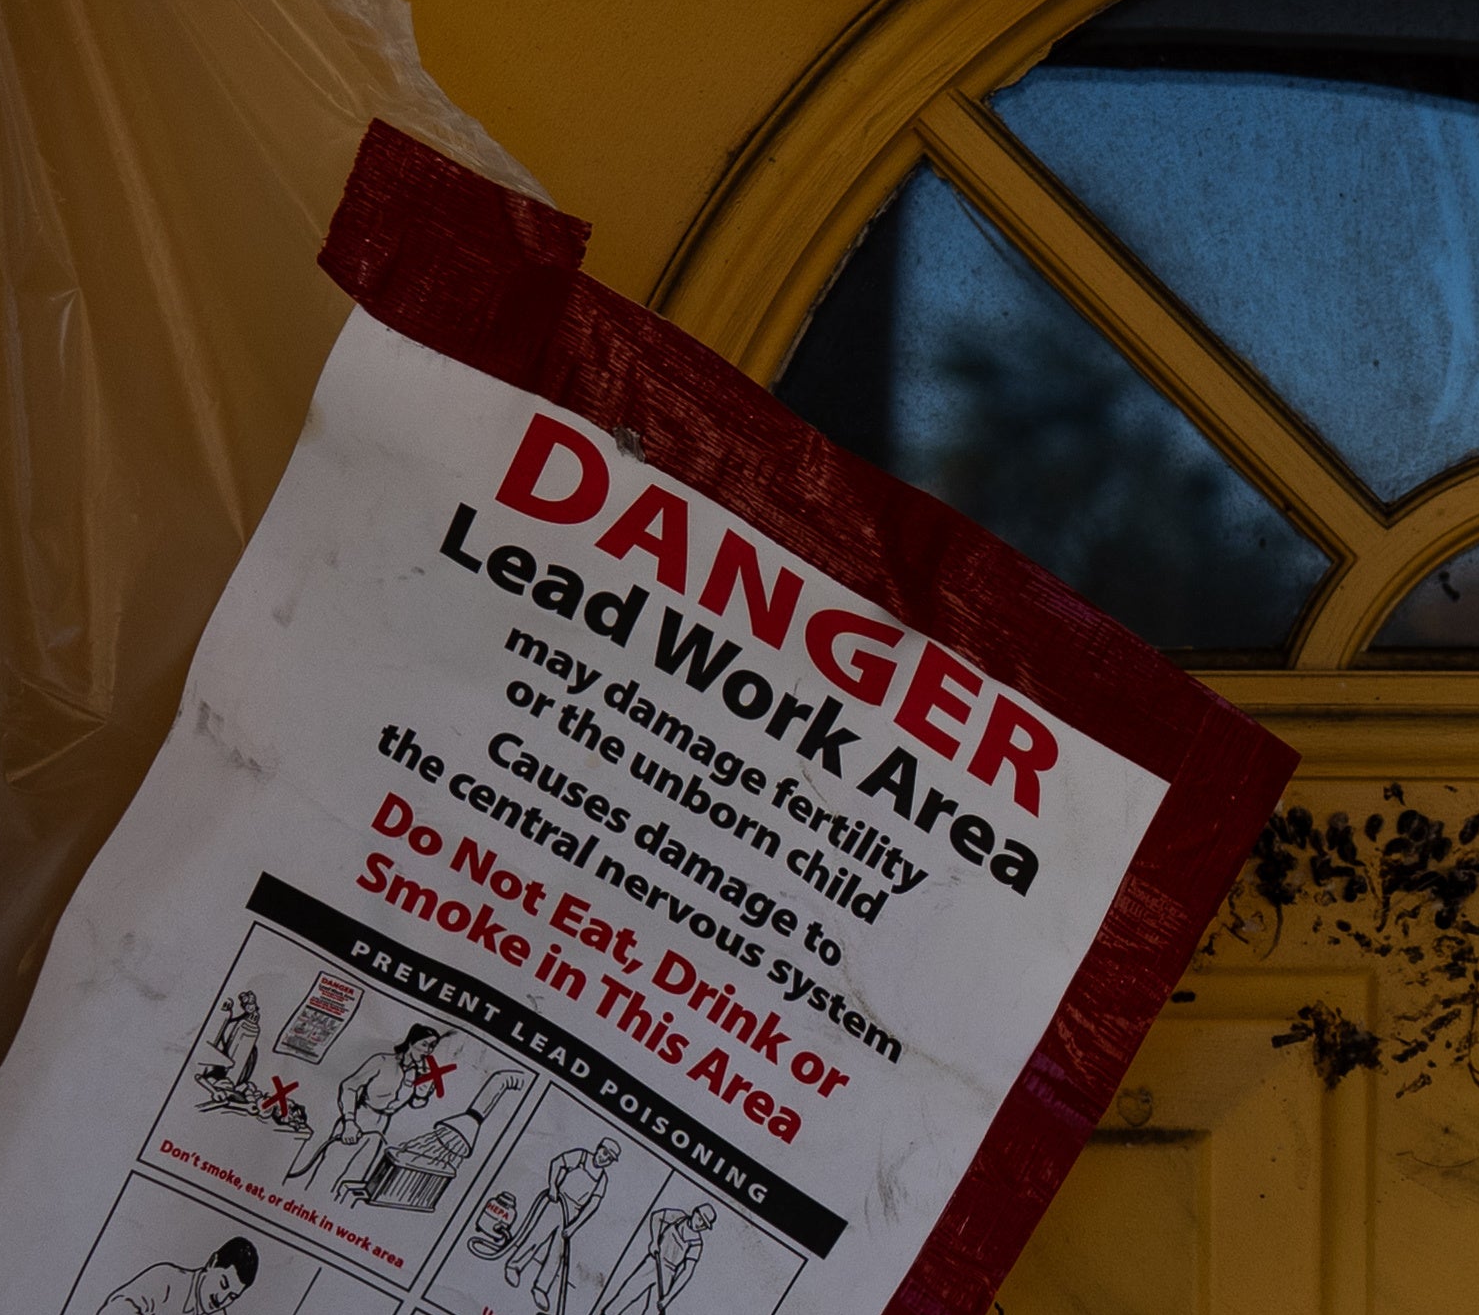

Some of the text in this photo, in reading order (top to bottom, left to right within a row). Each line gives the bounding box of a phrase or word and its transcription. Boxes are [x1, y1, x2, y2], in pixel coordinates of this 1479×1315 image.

[438, 501, 1039, 897] Lead Work Area
[494, 412, 1058, 817] DANGER
[377, 723, 902, 1064] the central nervous system
[487, 731, 841, 966] Causes damage to
[503, 627, 929, 895] may damage fertility
[505, 679, 889, 925] or the unborn child
[349, 939, 501, 1022] PREVENT
[509, 1020, 591, 1079] LEAD
[598, 1077, 768, 1204] POISONING
[355, 852, 801, 1144] Smoke in This Area
[370, 791, 850, 1098] Do Not Eat, Drink or
[199, 1160, 243, 1190] smoke,
[244, 1182, 265, 1200] eat,
[267, 1193, 283, 1206] or
[282, 1199, 318, 1224] drink
[318, 1214, 334, 1231] in
[335, 1225, 371, 1251] work
[371, 1245, 404, 1268] area
[485, 1201, 510, 1222] HEPA
